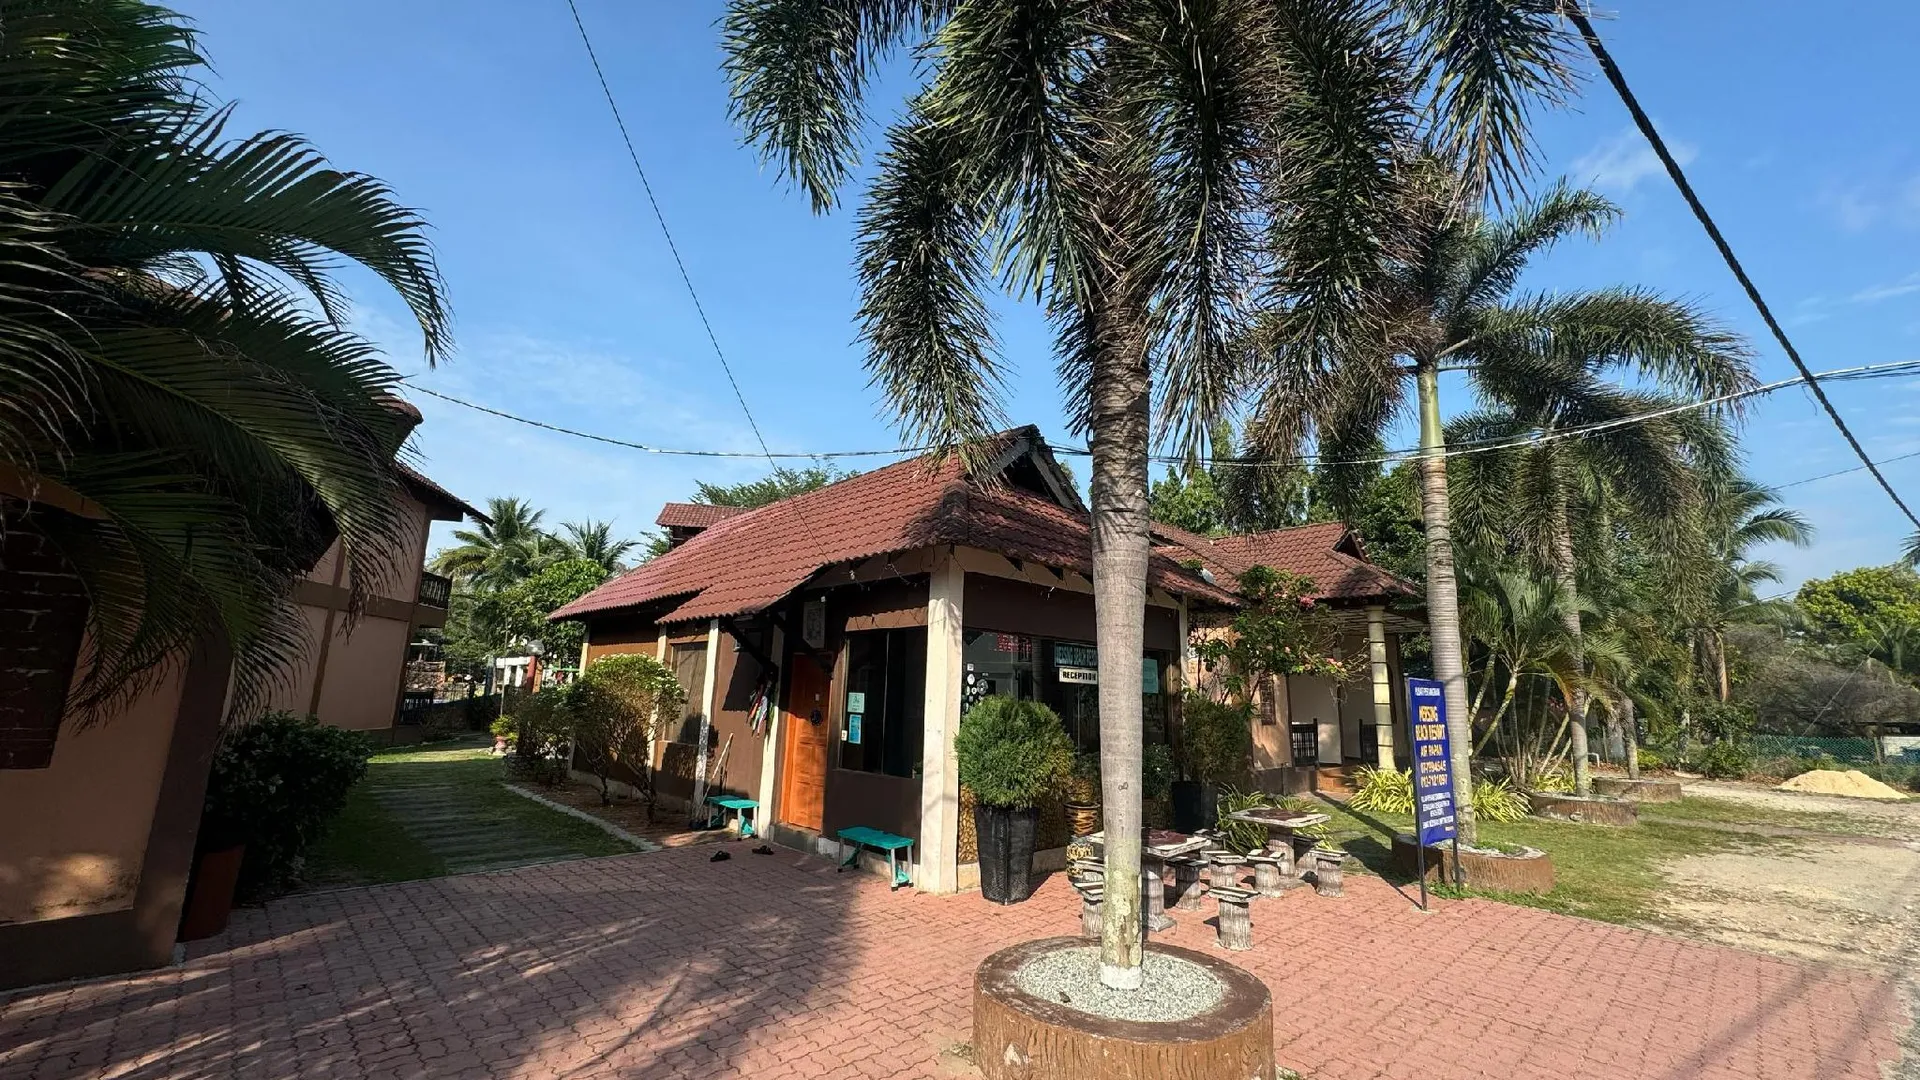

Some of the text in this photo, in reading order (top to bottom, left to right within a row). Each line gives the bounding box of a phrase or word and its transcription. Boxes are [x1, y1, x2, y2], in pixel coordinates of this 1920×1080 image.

[1063, 672, 1097, 681] RECEPTION
[1419, 706, 1438, 722] MERSING
[1416, 724, 1446, 741] BEACH RESORT
